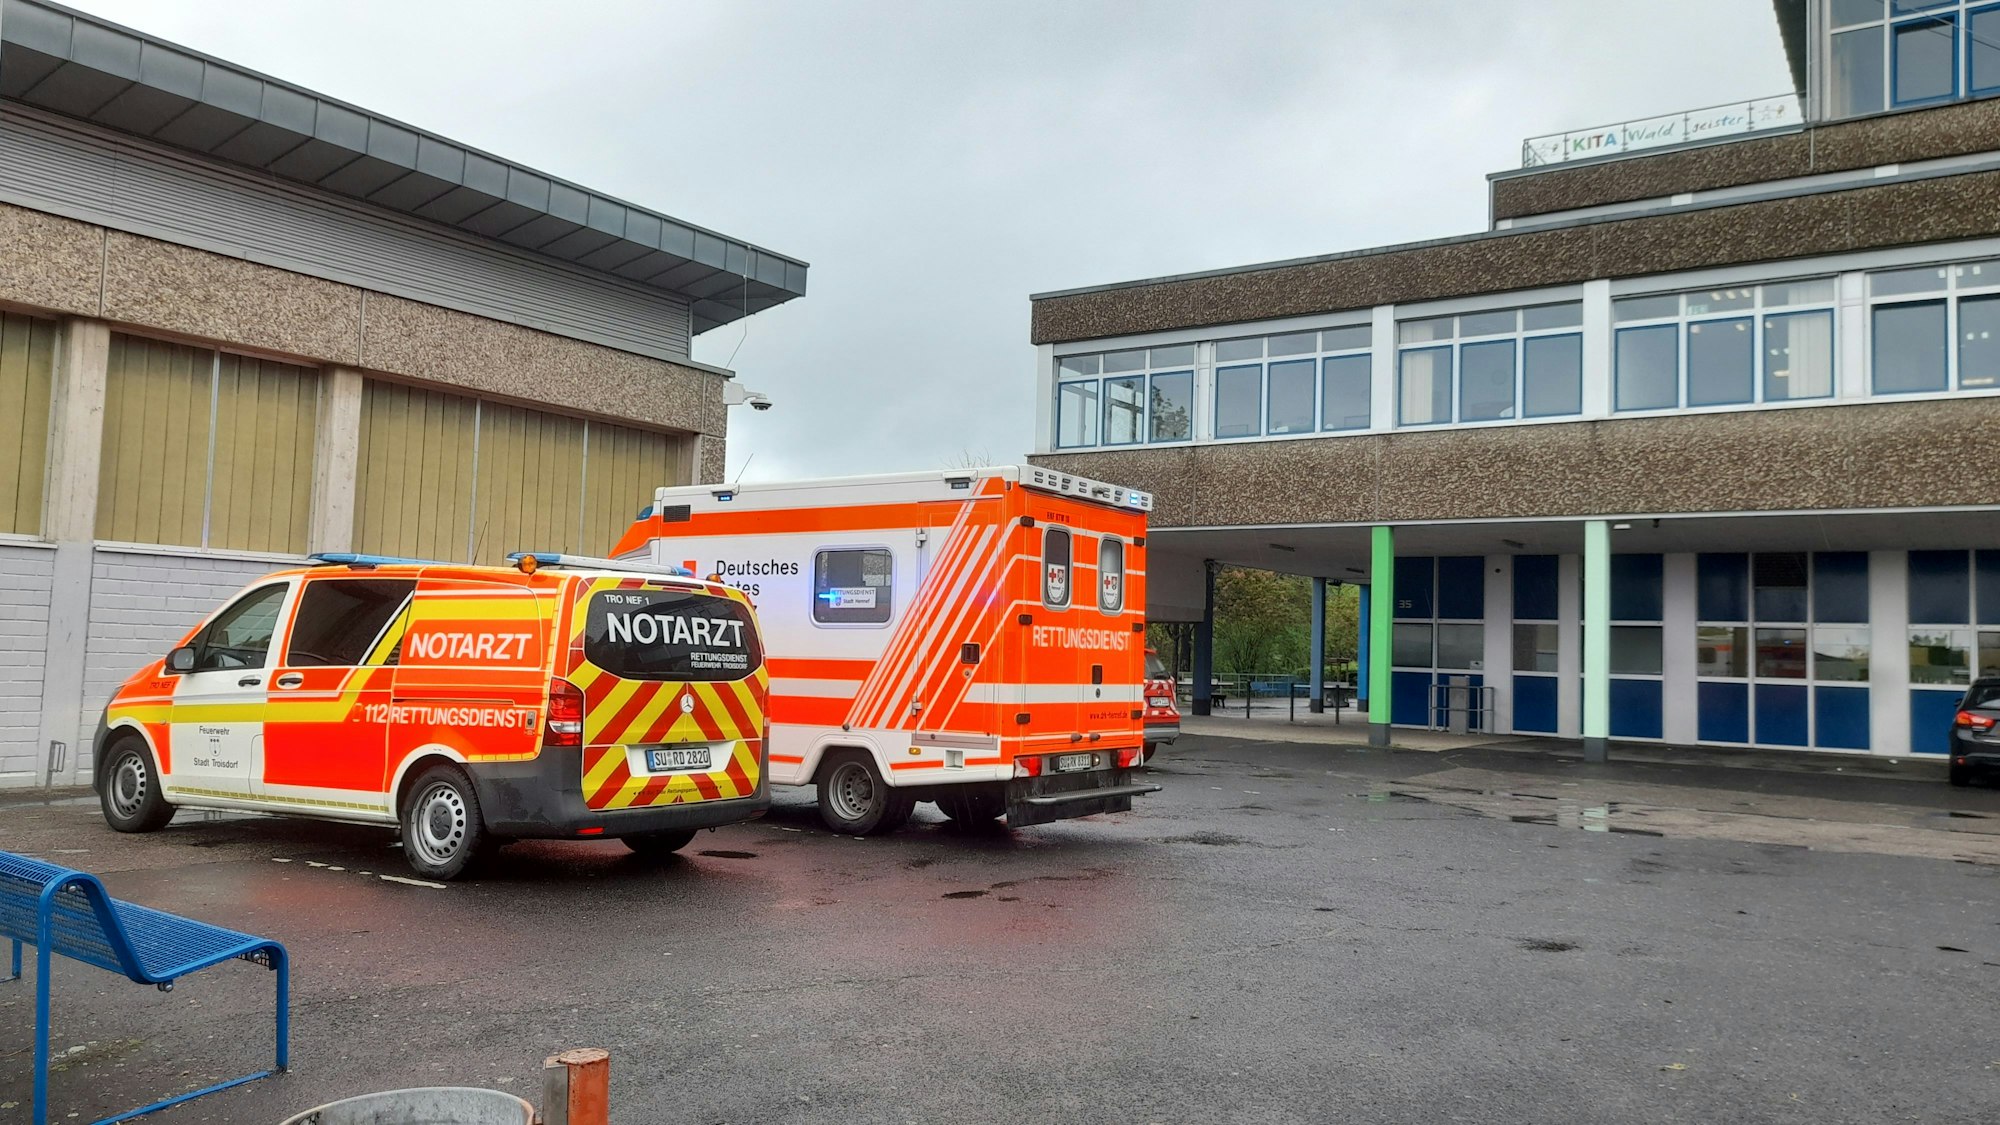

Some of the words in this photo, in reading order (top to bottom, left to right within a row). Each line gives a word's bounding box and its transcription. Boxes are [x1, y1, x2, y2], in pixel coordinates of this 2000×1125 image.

[1573, 133, 1617, 152] KITA
[1628, 122, 1676, 142] Wald
[1692, 115, 1744, 133] geister
[716, 559, 799, 576] Deutsches
[604, 594, 624, 604] TRO
[626, 595, 643, 605] NEF
[645, 597, 650, 606] 1
[606, 612, 744, 648] NOTARZT
[1032, 625, 1131, 651] RETTUNGSDIENST
[408, 632, 533, 660] NOTARZT
[690, 651, 748, 663] RETTUNGSDIENST
[690, 661, 722, 669] FEUERWEHR
[722, 662, 748, 670] TROISDORF
[365, 703, 388, 723] 112
[390, 706, 527, 728] RETTUNGSDIENST
[199, 725, 230, 735] Feuerwehr
[194, 757, 210, 767] Stadt
[211, 758, 239, 769] Troisdorf
[654, 752, 668, 766] SU
[673, 751, 685, 765] RD
[686, 750, 709, 764] 2820
